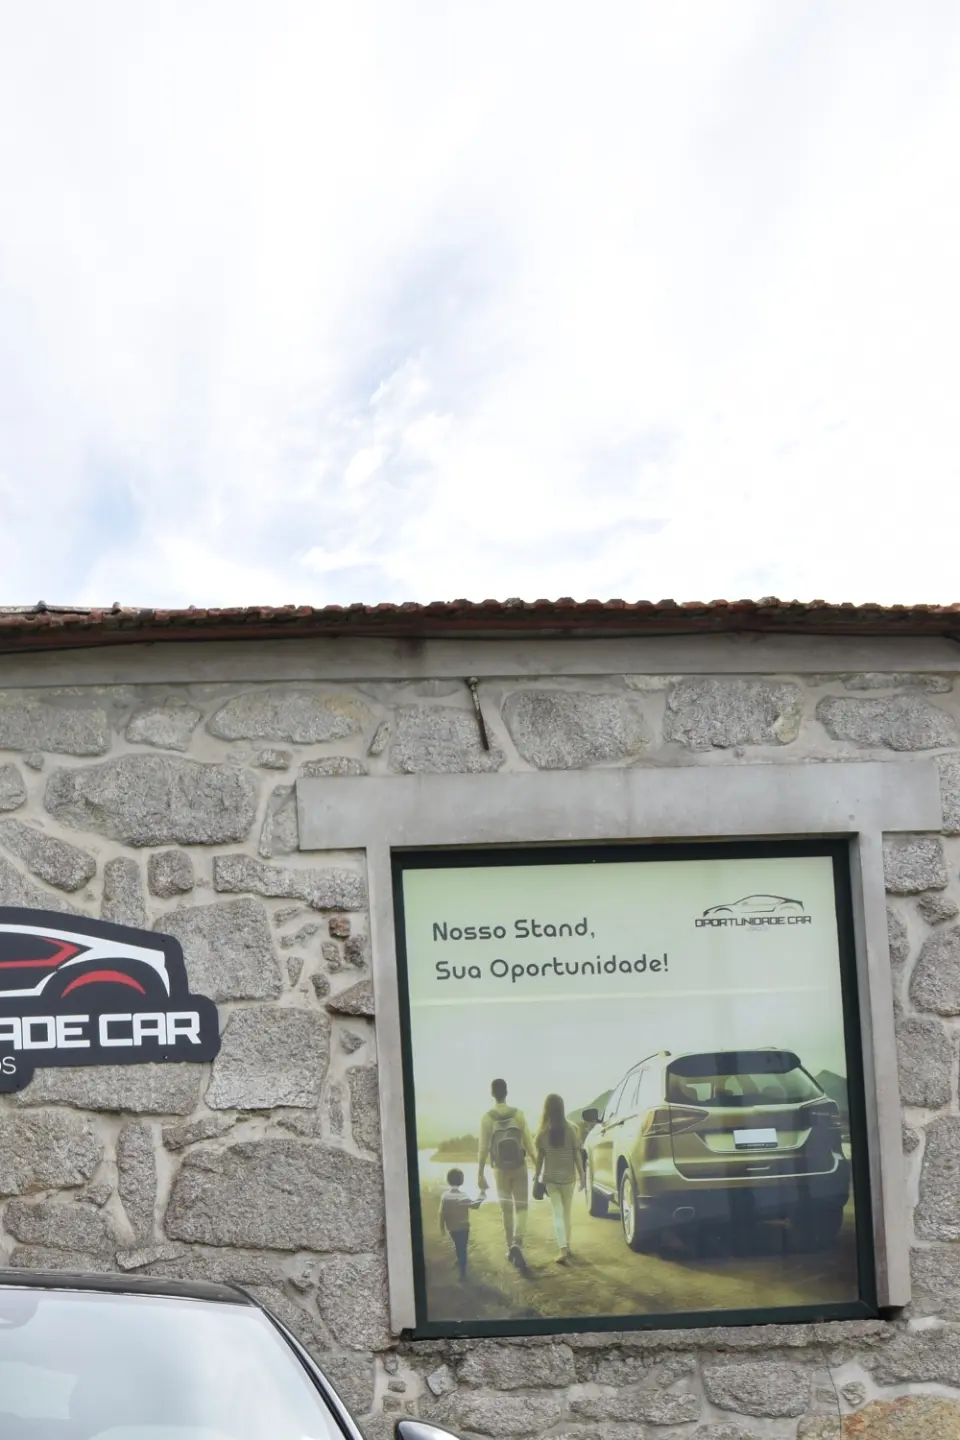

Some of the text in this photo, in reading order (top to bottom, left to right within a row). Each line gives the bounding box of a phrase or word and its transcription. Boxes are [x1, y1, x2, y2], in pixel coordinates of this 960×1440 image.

[432, 917, 596, 942] Nosso Stand,
[694, 915, 812, 928] OPORTUNIDADE CAR
[435, 953, 669, 983] Sua Oportunidade!
[98, 1011, 202, 1047] CAR
